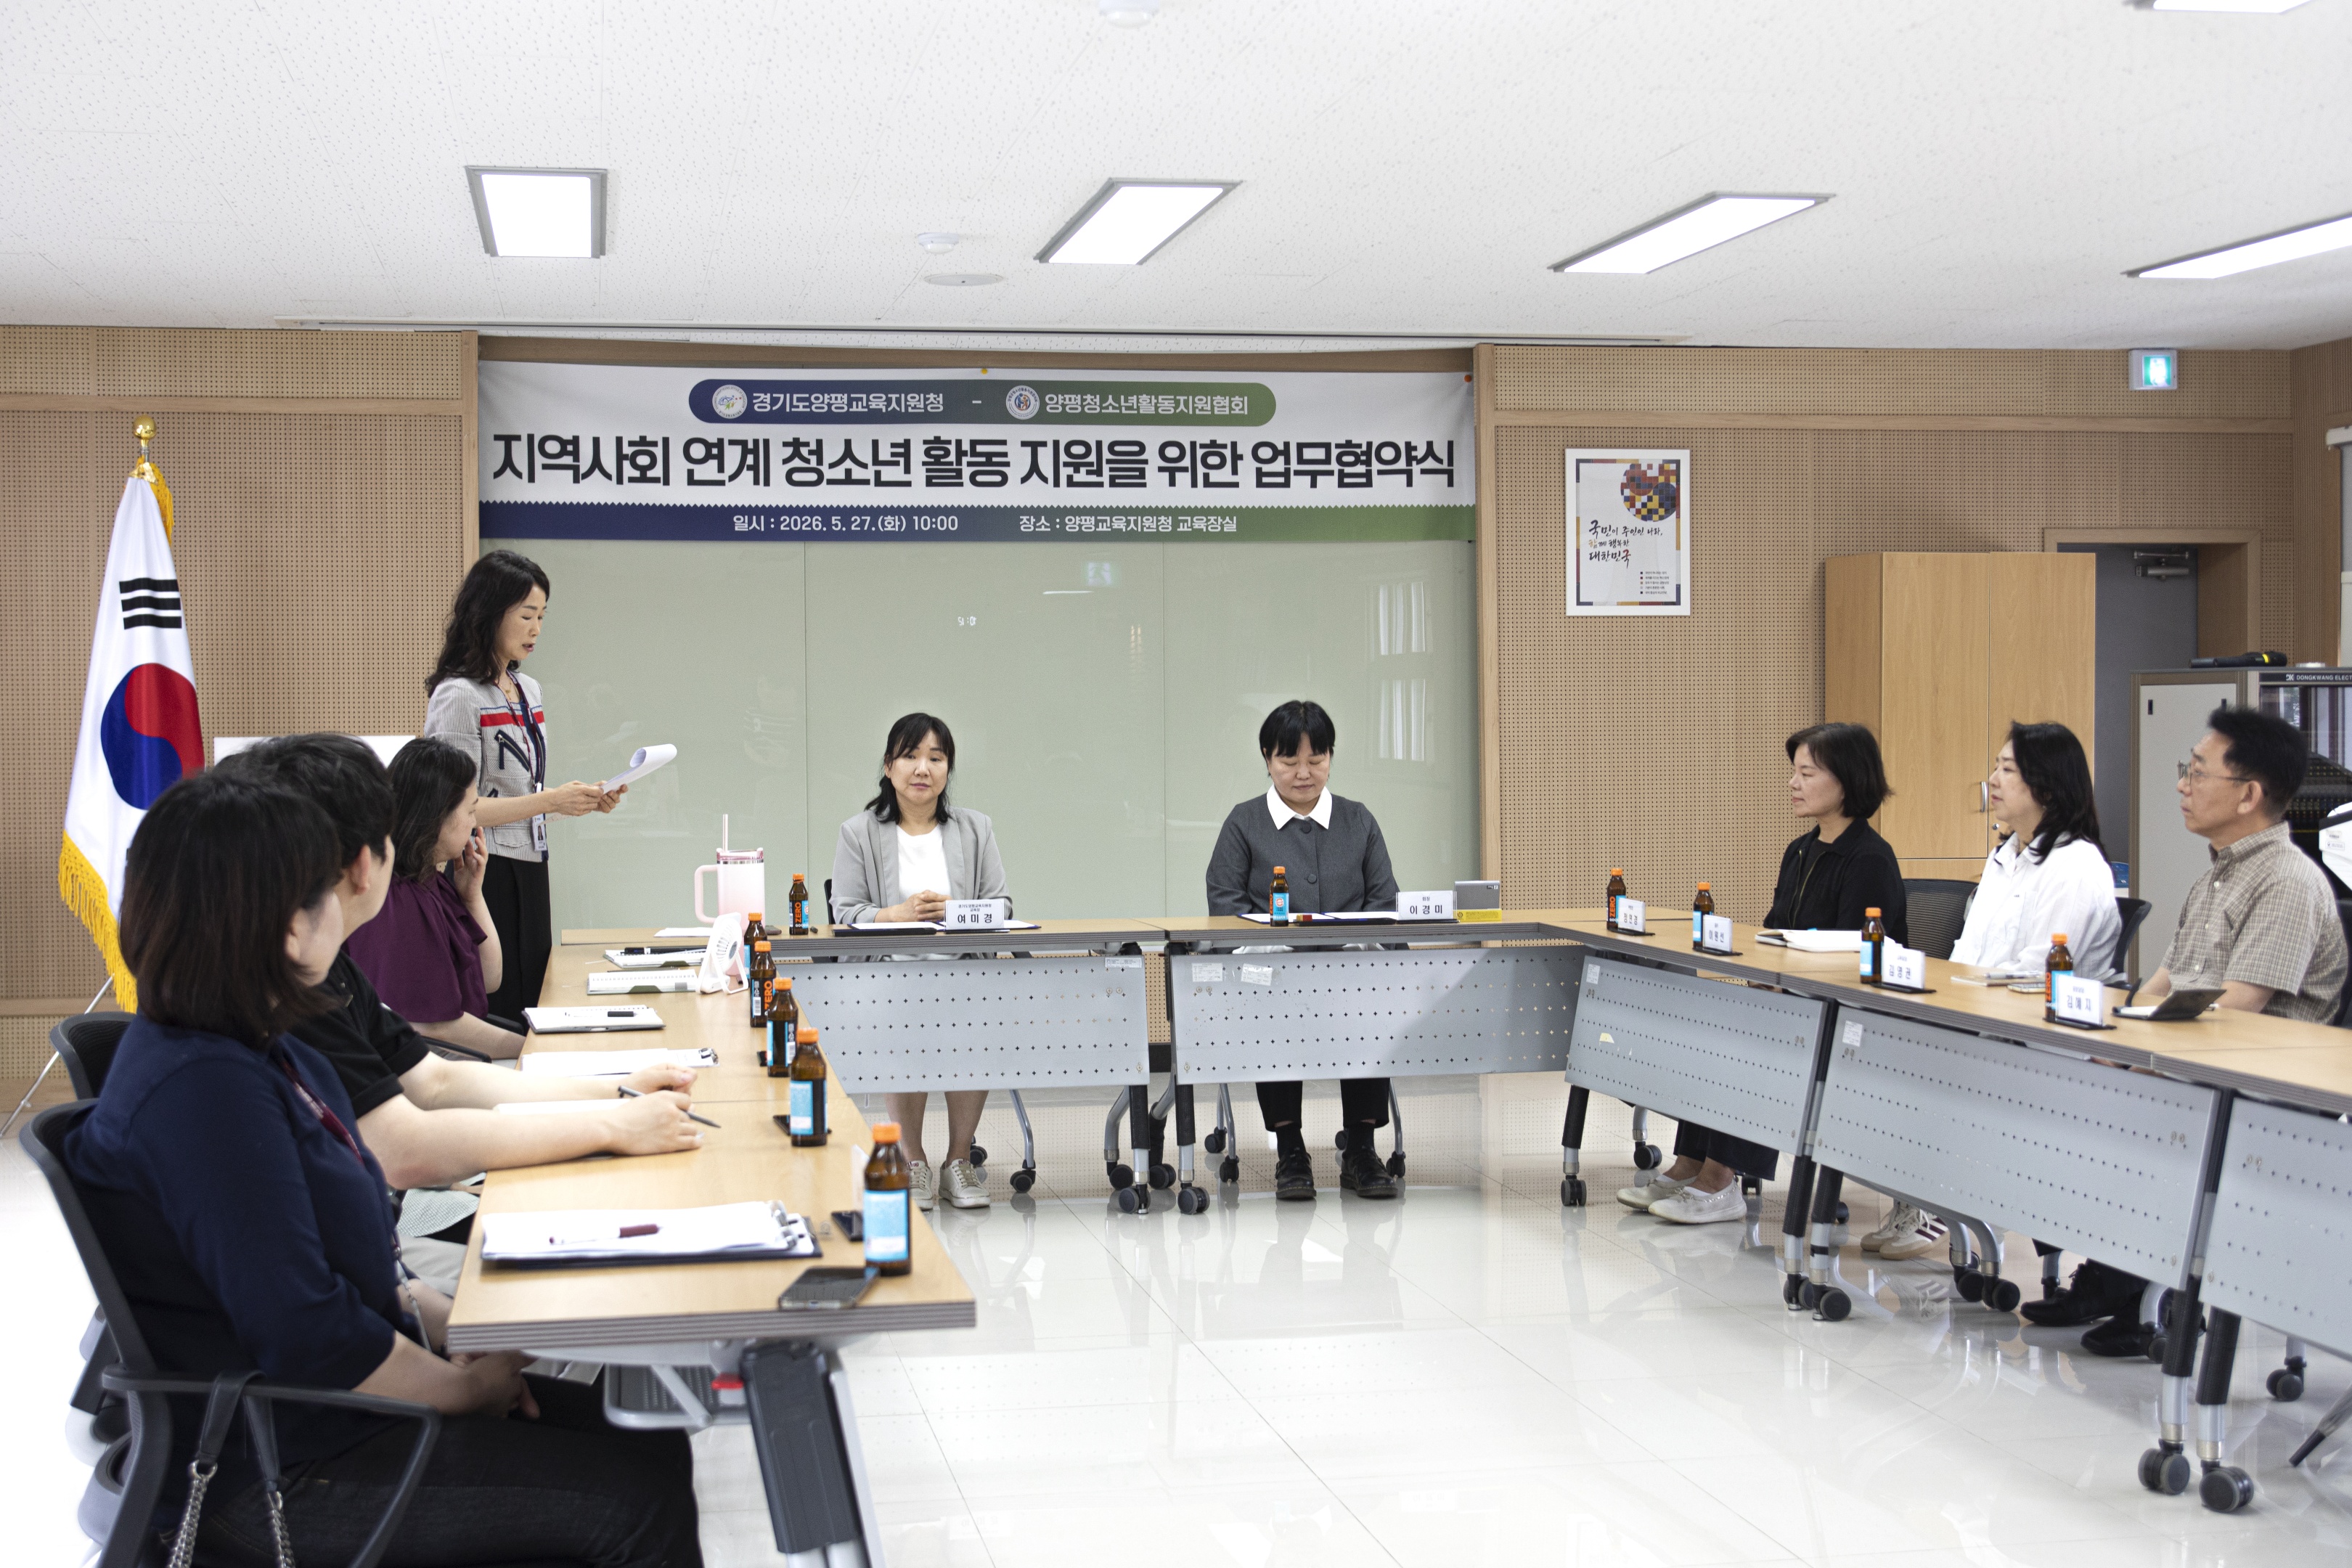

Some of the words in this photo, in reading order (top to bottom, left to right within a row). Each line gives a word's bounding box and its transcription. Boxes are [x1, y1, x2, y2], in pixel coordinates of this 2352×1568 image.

[753, 392, 944, 413] 경기도양평교육지원청
[1045, 393, 1248, 415] 양평청소년활동지원협회
[493, 433, 670, 486] 지역사회
[682, 437, 770, 487] 연계
[782, 437, 912, 488] 청소년
[921, 436, 1010, 488] 활동
[1020, 439, 1148, 489] 지원을
[1157, 439, 1244, 489] 위한
[1251, 439, 1454, 489] 업무협약식
[733, 515, 764, 531] 일시
[780, 515, 827, 531] 2026.
[831, 515, 846, 531] 5.
[912, 515, 958, 531] 10:00
[1019, 515, 1051, 532] 장소
[1065, 515, 1172, 532] 양평교육지원청
[1177, 515, 1237, 532] 교육장실
[1589, 519, 1618, 539] 국민이
[1622, 526, 1644, 537] 주인인
[1588, 539, 1607, 549] 함께
[1608, 539, 1630, 548] 행복한
[1589, 549, 1631, 569] 대한민국
